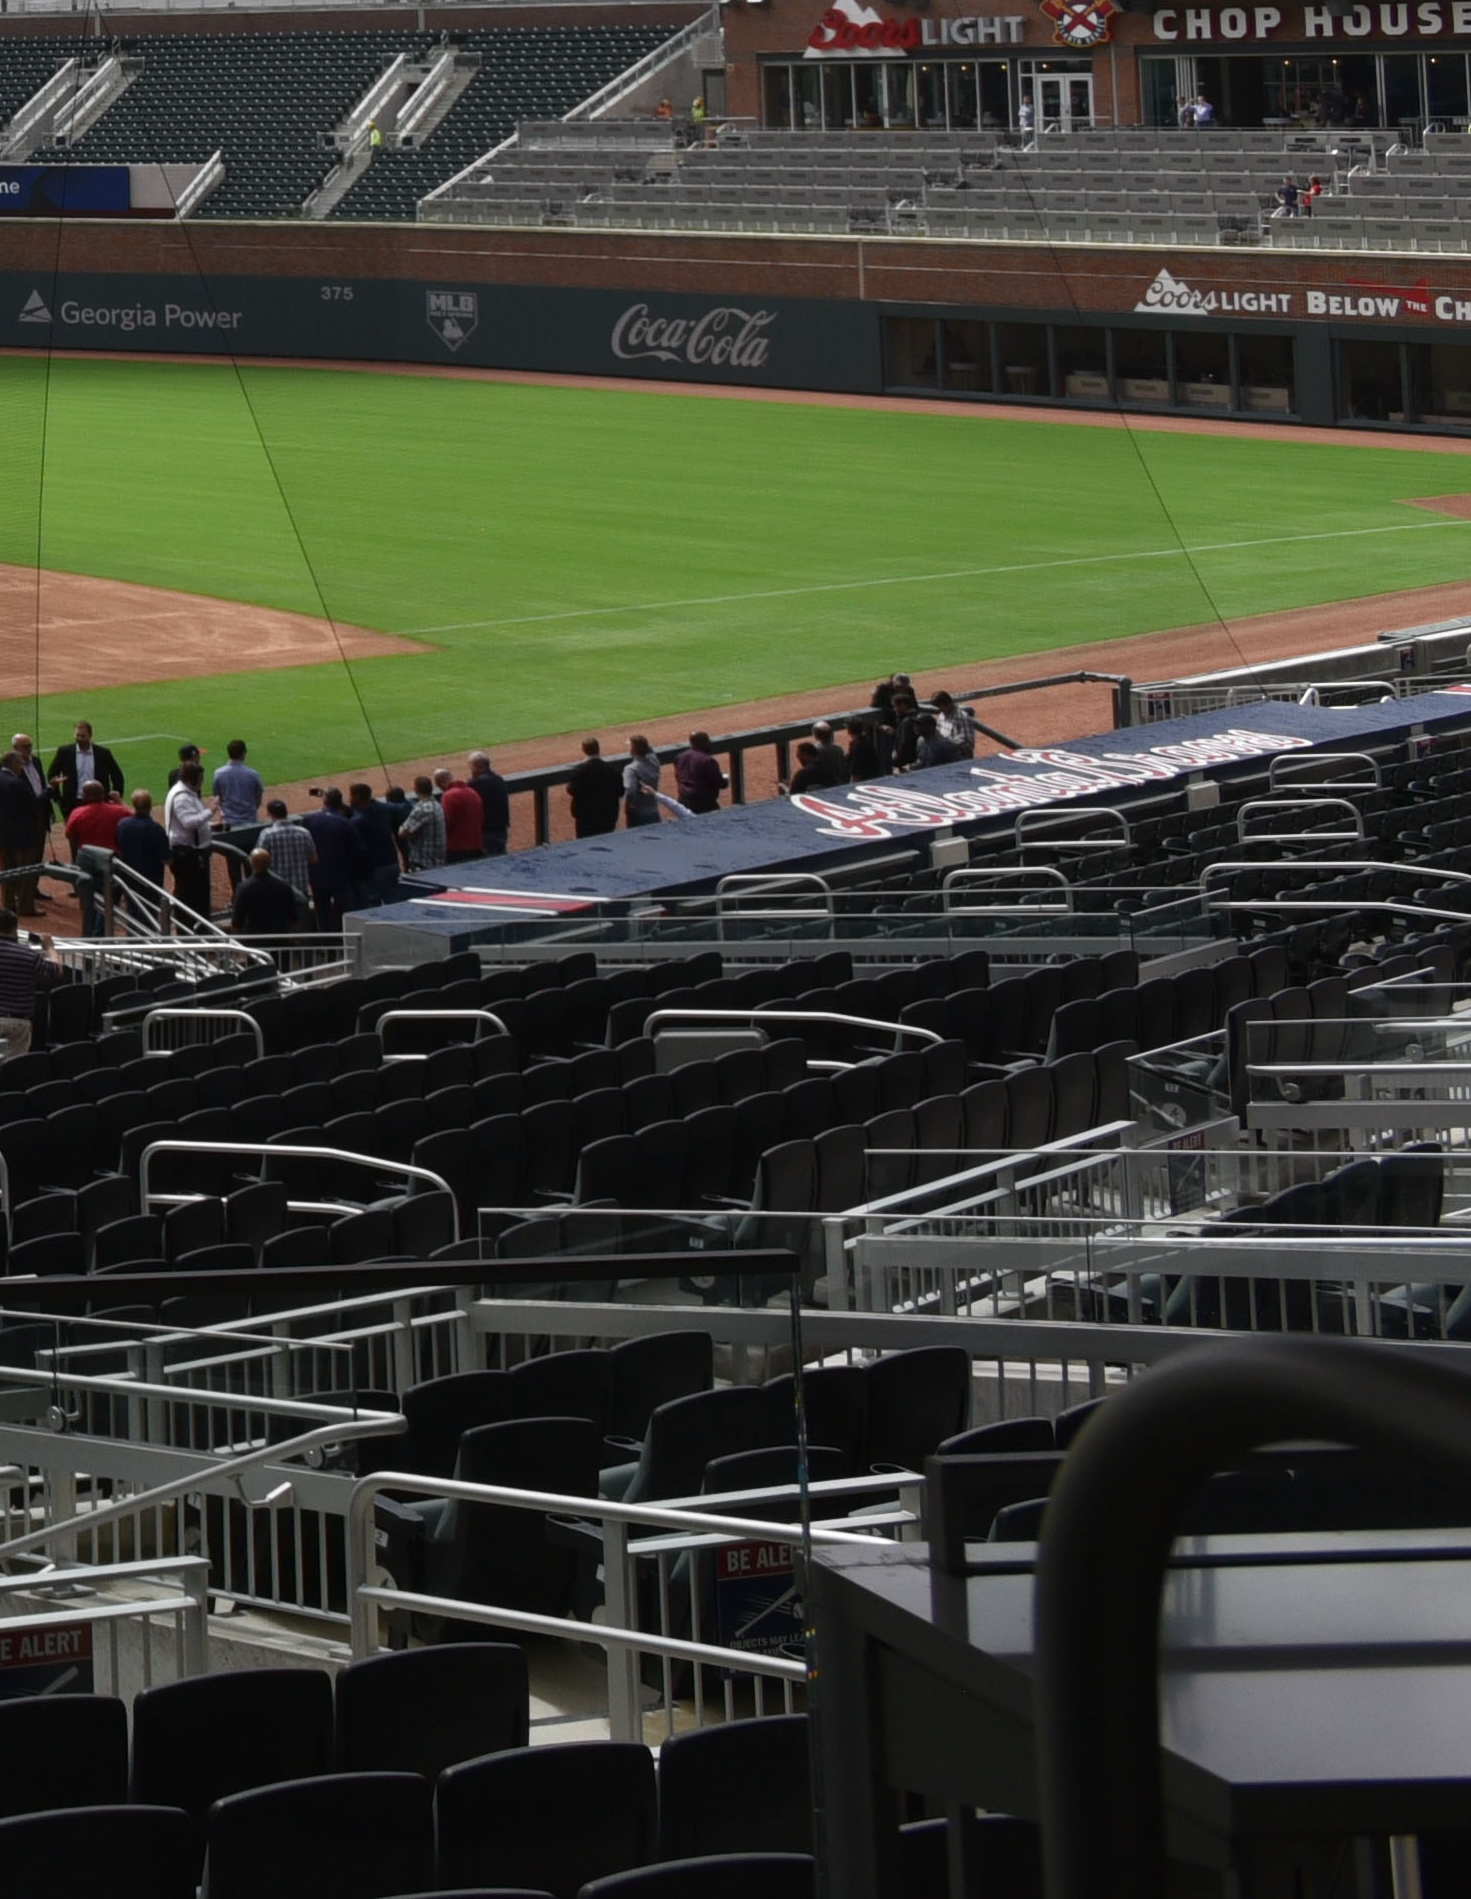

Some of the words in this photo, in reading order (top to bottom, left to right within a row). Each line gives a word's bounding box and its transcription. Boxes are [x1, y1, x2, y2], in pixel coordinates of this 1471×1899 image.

[807, 7, 920, 50] Coors
[920, 14, 1024, 46] LIGHT
[1152, 5, 1281, 41] CHOP
[1304, 2, 1471, 38] HOUSE
[320, 286, 355, 301] 375
[429, 292, 475, 312] MLB
[1143, 281, 1220, 311] Coors
[1221, 291, 1292, 313] LIGHT
[1306, 290, 1400, 318] BELOW
[1405, 299, 1428, 312] THE
[60, 301, 157, 332] Georgia
[164, 304, 243, 331] Power
[611, 302, 779, 369] Coca-Cola
[727, 1548, 751, 1573] BE
[756, 1544, 795, 1569] ALE
[19, 1629, 83, 1659] ALERT
